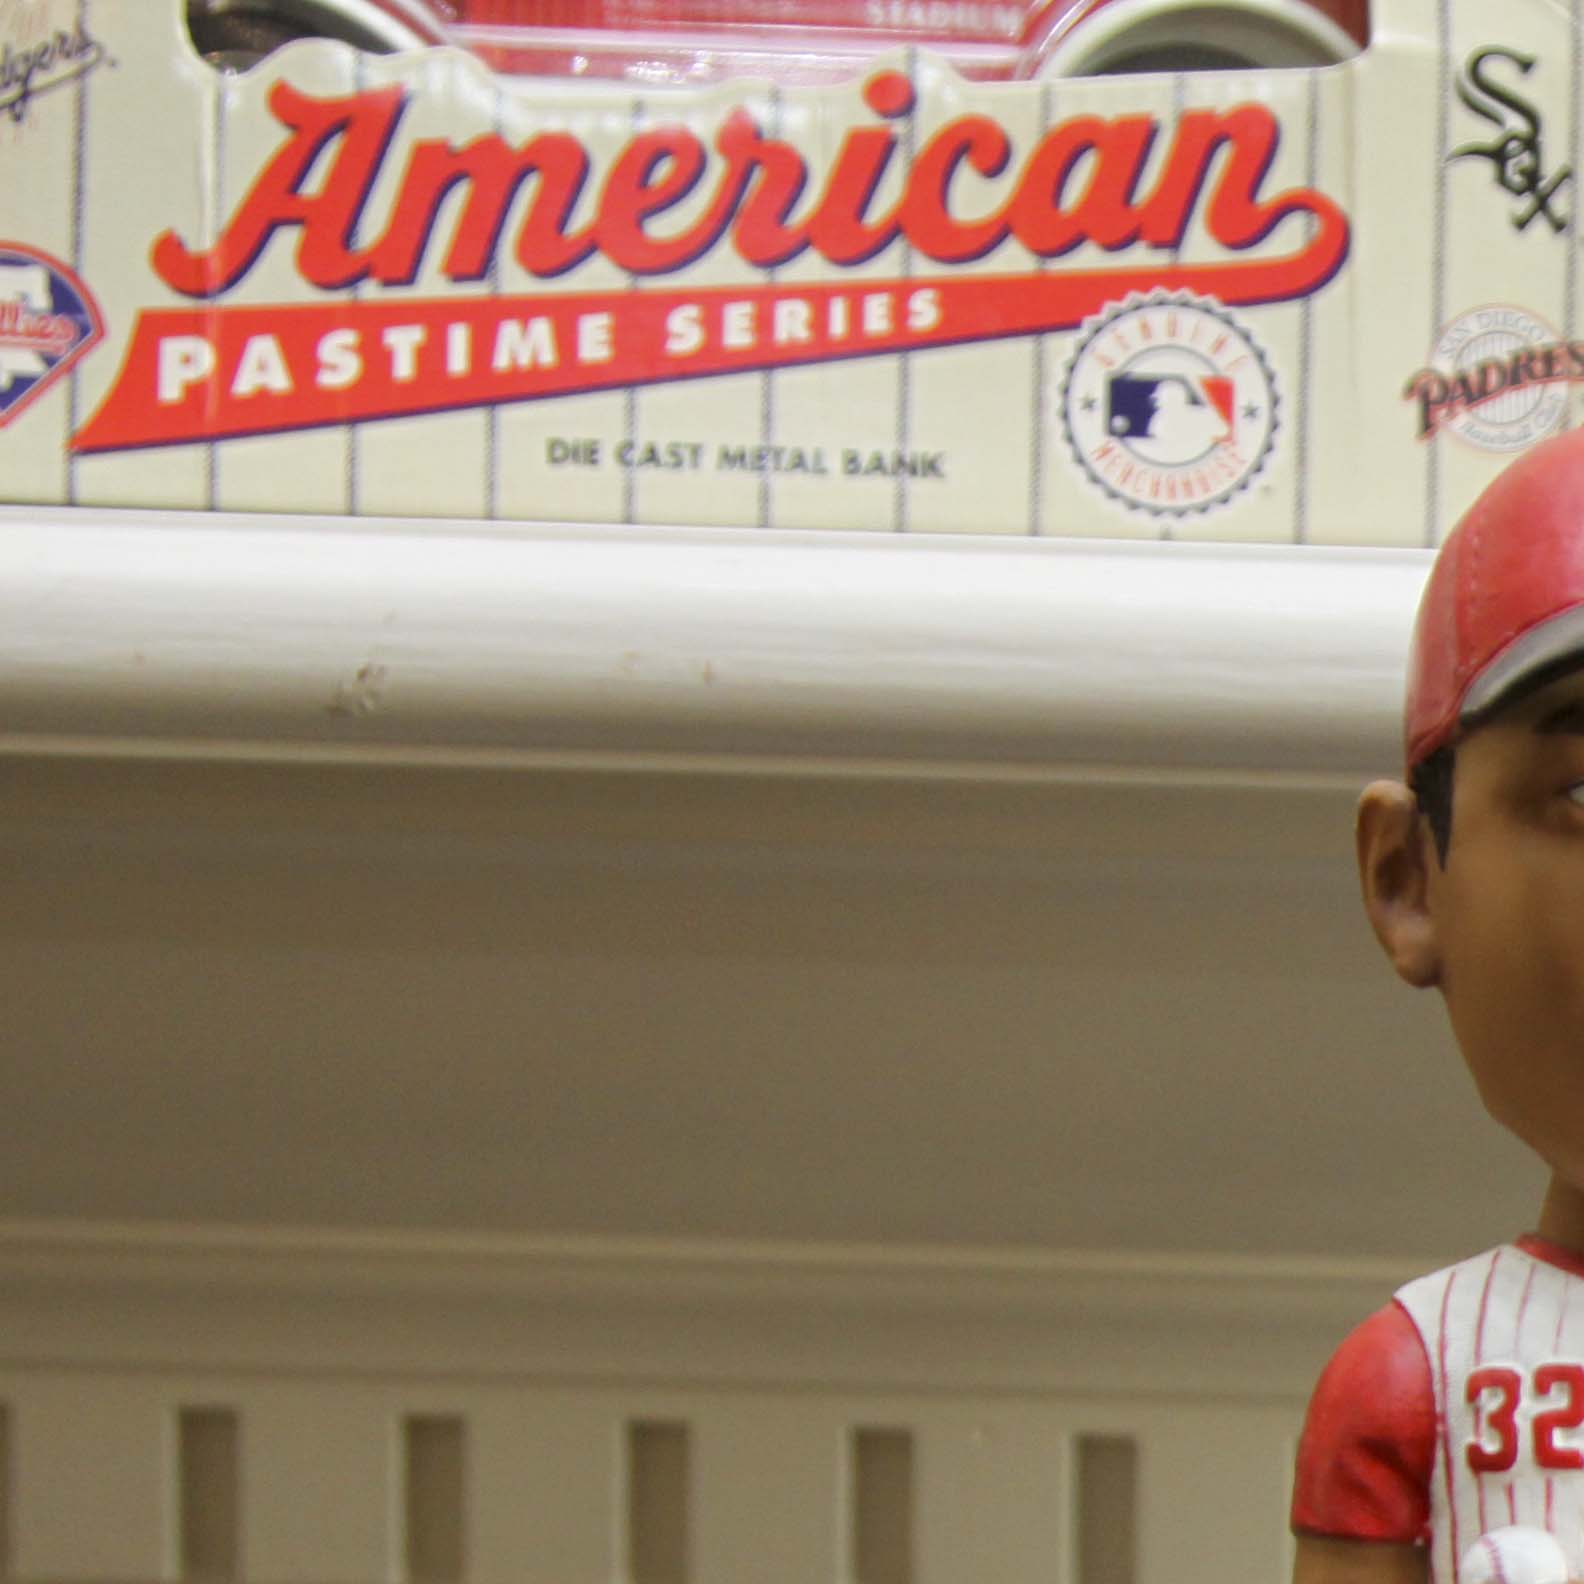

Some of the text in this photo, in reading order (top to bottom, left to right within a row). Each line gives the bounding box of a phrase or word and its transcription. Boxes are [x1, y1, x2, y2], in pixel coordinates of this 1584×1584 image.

[150, 70, 1349, 298] American
[157, 288, 942, 403] PASTIME SERIES
[546, 436, 947, 481] DIE CAST METAL BANK
